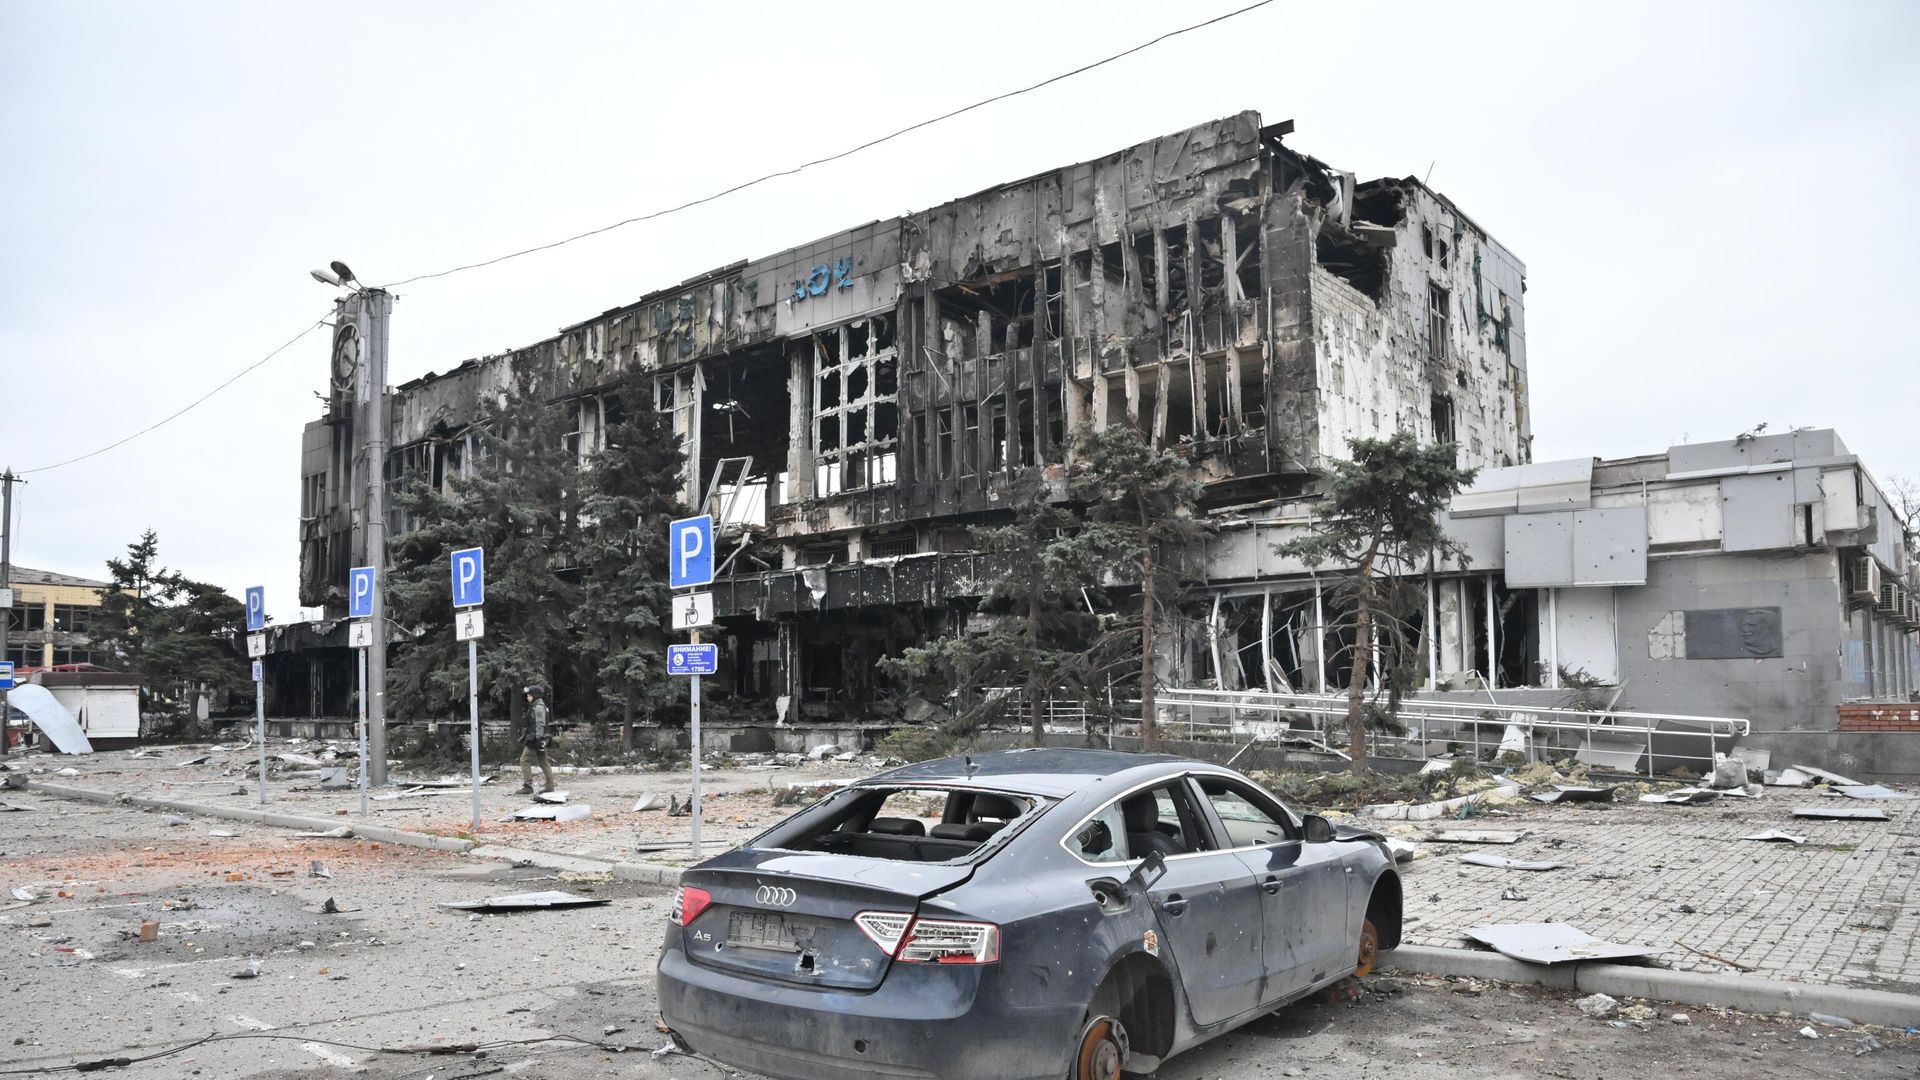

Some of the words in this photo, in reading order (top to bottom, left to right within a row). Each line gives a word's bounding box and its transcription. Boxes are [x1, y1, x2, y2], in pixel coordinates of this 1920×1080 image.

[681, 526, 703, 578] P
[355, 573, 369, 611] P
[459, 556, 475, 599] P
[250, 592, 260, 625] P
[693, 930, 712, 942] A5
